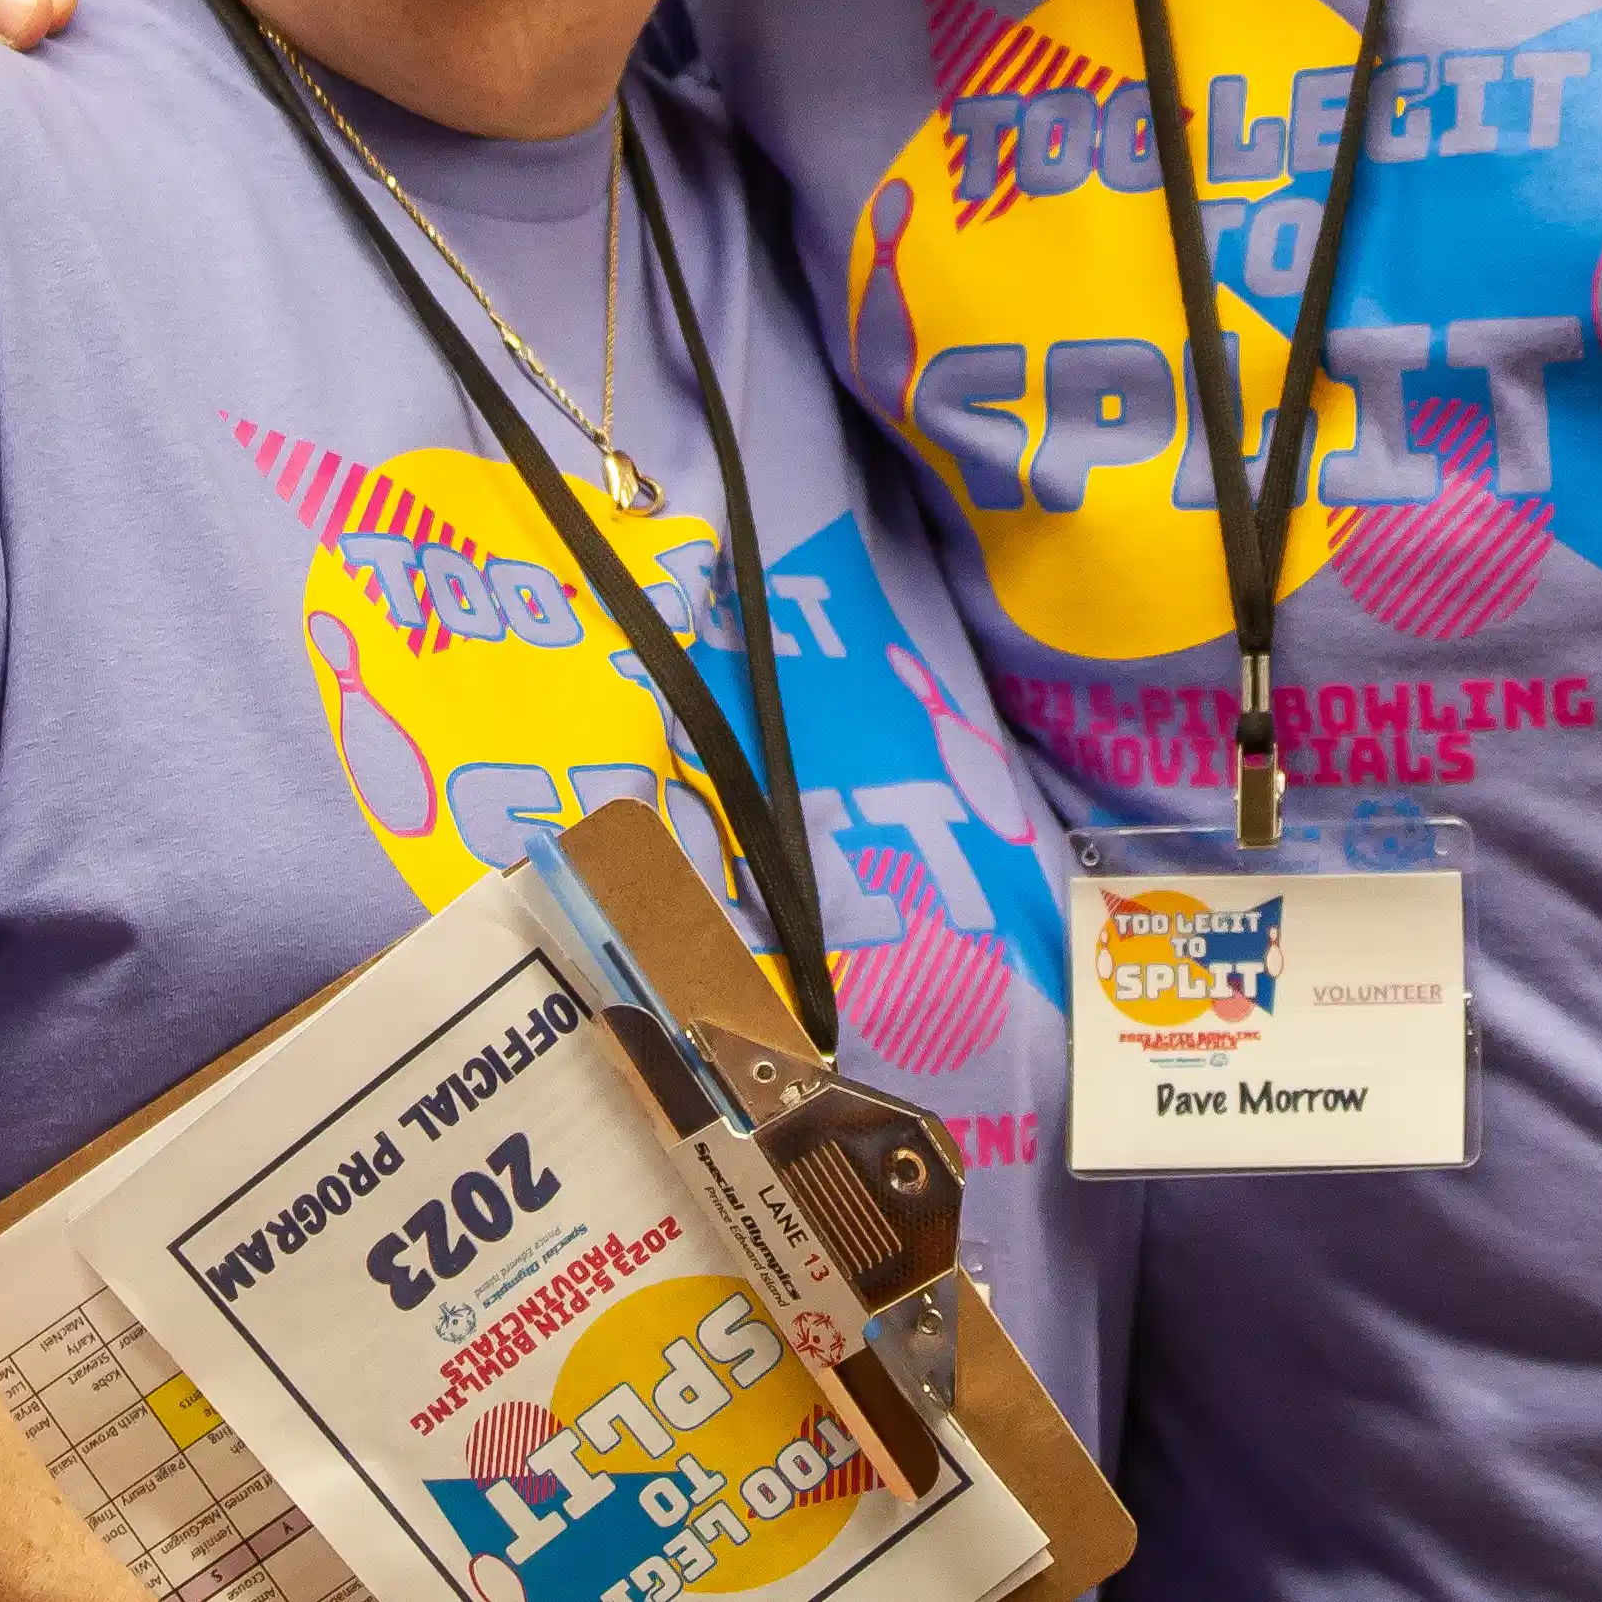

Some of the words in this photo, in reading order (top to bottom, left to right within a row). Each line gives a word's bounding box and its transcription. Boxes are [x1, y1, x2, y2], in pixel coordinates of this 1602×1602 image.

[949, 80, 1168, 203] TOO
[1206, 50, 1591, 185] LEGIT
[912, 314, 1585, 514] SPLIT
[339, 532, 584, 648] TOO
[1270, 676, 1597, 738] BOWLING
[1114, 912, 1170, 935] TOO
[1175, 910, 1262, 935] LEGIT
[1170, 937, 1207, 959] TO
[1115, 961, 1265, 1001] SPLIT
[1312, 983, 1443, 1005] VOLUNTEER
[398, 993, 579, 1142] OFFICIAL
[1156, 1082, 1228, 1117] Dave
[1237, 1079, 1368, 1116] Morrow
[204, 1131, 406, 1302] PROGRAM
[366, 1132, 562, 1312] 2023
[694, 1141, 746, 1212] Special
[740, 1214, 802, 1301] Olympics
[758, 1184, 809, 1249] LANE
[804, 1253, 830, 1282] 13
[611, 1214, 683, 1277] 2023
[703, 1186, 733, 1225] Prince
[729, 1224, 767, 1272] Edward
[760, 1272, 791, 1308] Island
[439, 1231, 626, 1385] PROVINCIALS
[533, 1267, 616, 1341] 5-PIN
[40, 1316, 85, 1353] MacNeil
[66, 1332, 97, 1356] Karly
[67, 1351, 111, 1386] Stewart
[91, 1368, 123, 1393] Kobe
[409, 1329, 539, 1438] BOWLING
[80, 1425, 120, 1455] Brown
[121, 1404, 150, 1430] Keith
[484, 1292, 785, 1566] SPLIT
[121, 1482, 158, 1507] Fleury
[638, 1452, 728, 1528] TO
[739, 1414, 861, 1521] TOO
[160, 1509, 223, 1555] MacGuigan
[190, 1524, 235, 1561] Jennifer
[282, 1521, 295, 1536] Y
[210, 1568, 224, 1584] S
[226, 1570, 267, 1601] Crouse
